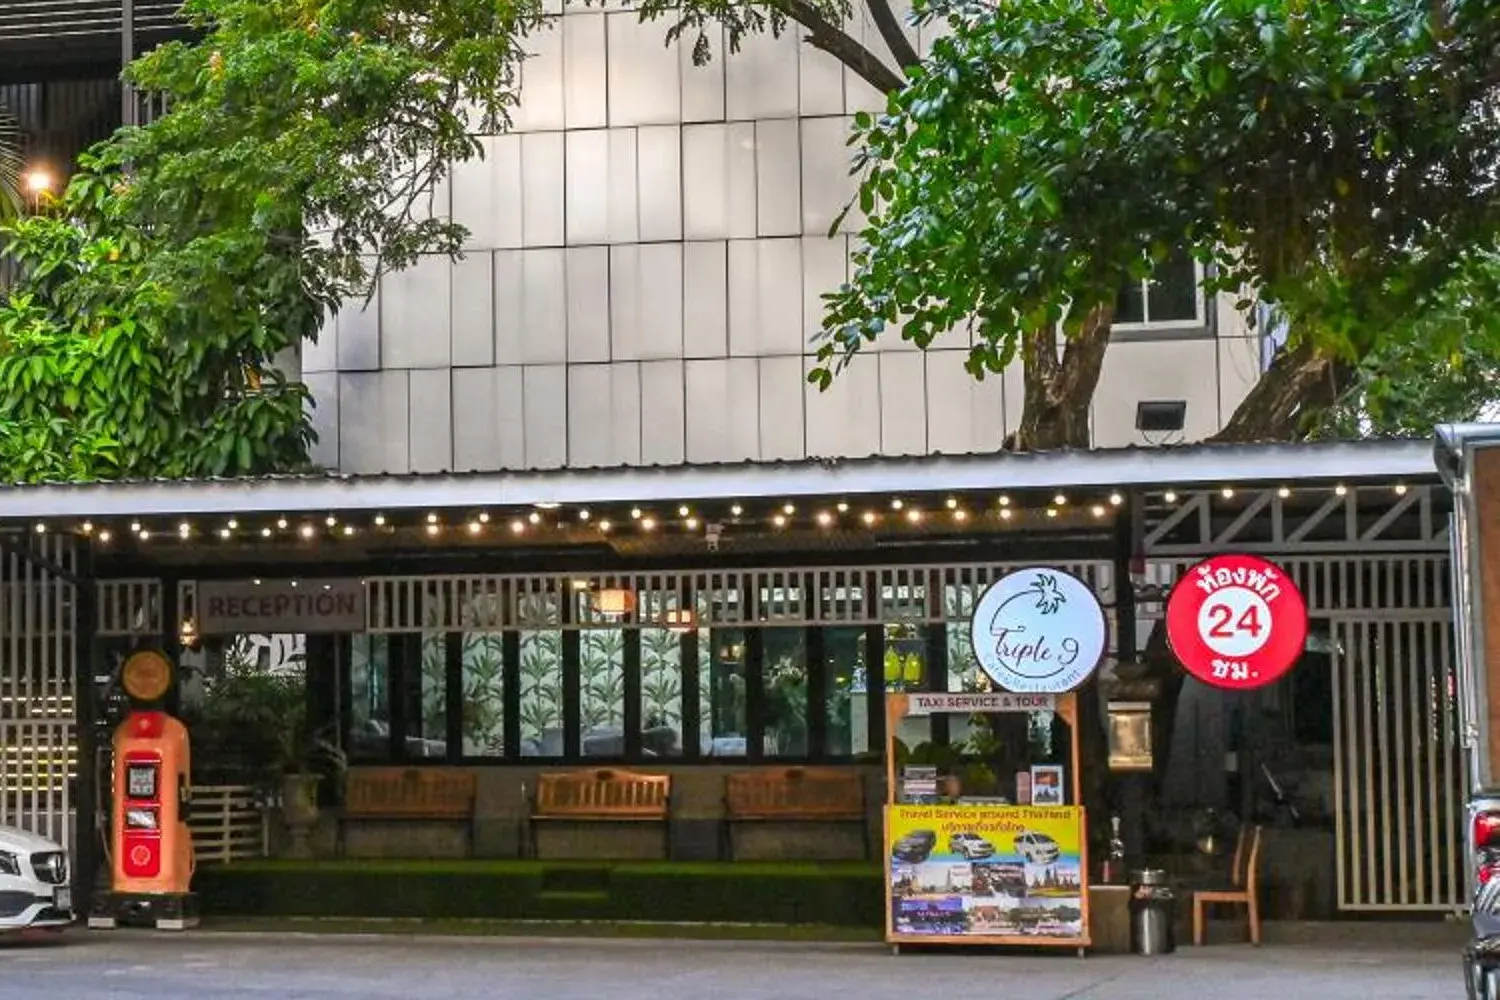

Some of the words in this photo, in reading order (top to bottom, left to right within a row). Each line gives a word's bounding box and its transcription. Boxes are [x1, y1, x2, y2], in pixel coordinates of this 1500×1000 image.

[1196, 564, 1282, 602] ห้องพัก
[208, 592, 357, 618] RECEPTION
[1208, 603, 1263, 638] 24
[990, 625, 1052, 668] Triple
[1058, 636, 1080, 666] 9
[1211, 659, 1259, 680] ชม.
[916, 697, 943, 708] TAXI
[947, 697, 999, 708] SERVICE
[1003, 697, 1012, 707] &
[1016, 696, 1048, 707] TOUR
[900, 809, 933, 819] Travel
[935, 809, 977, 819] Service
[1022, 809, 1071, 819] Thailand
